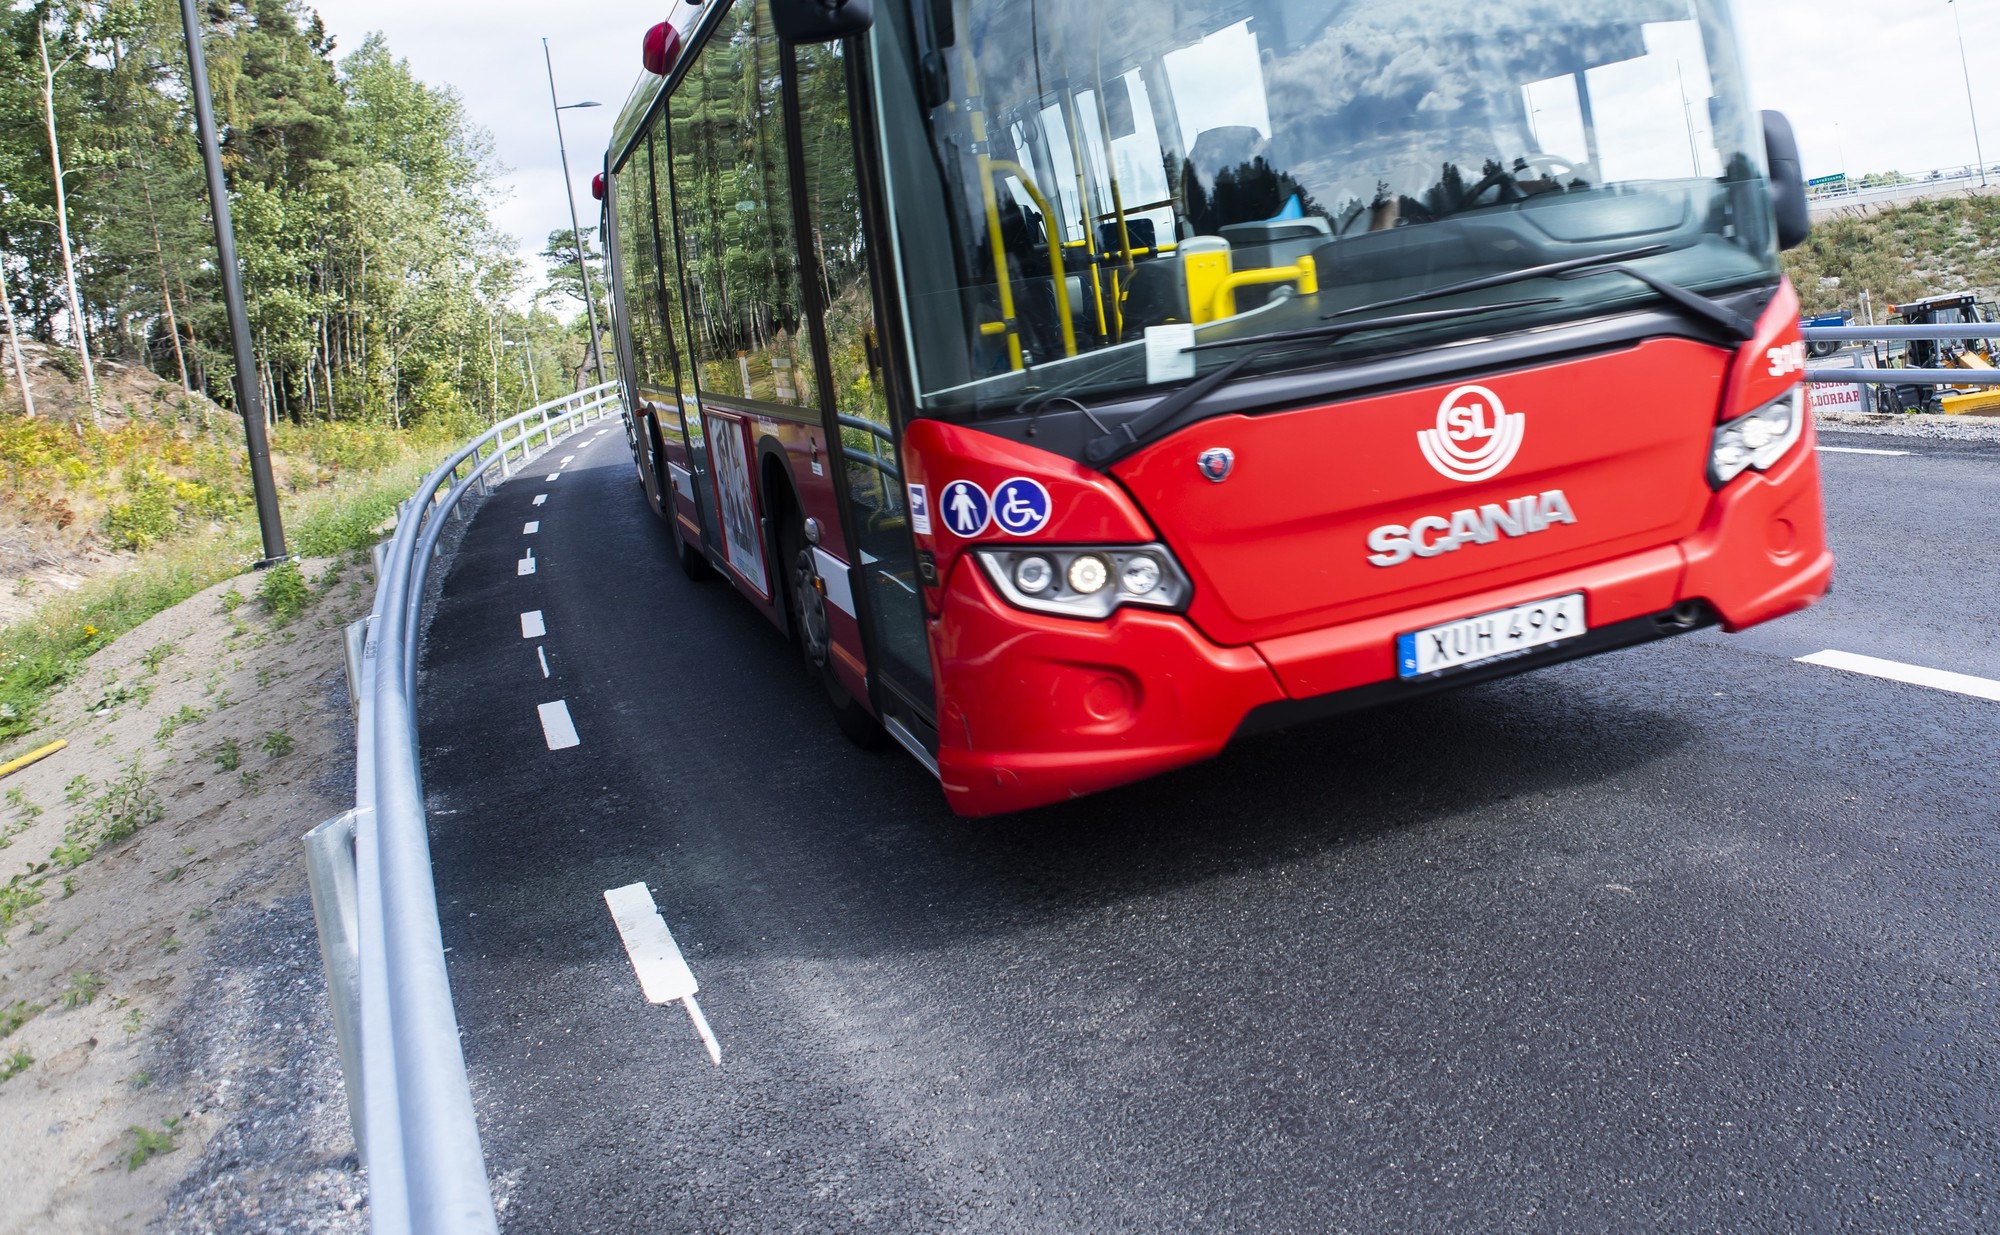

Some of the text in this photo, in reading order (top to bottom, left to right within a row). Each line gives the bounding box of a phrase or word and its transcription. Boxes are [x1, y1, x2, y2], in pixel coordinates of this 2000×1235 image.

[1447, 403, 1494, 441] SL
[1811, 390, 1860, 407] LDÖRRAR
[1367, 489, 1578, 567] SCANIA
[1431, 619, 1496, 664] XUH
[1508, 601, 1568, 641] 496
